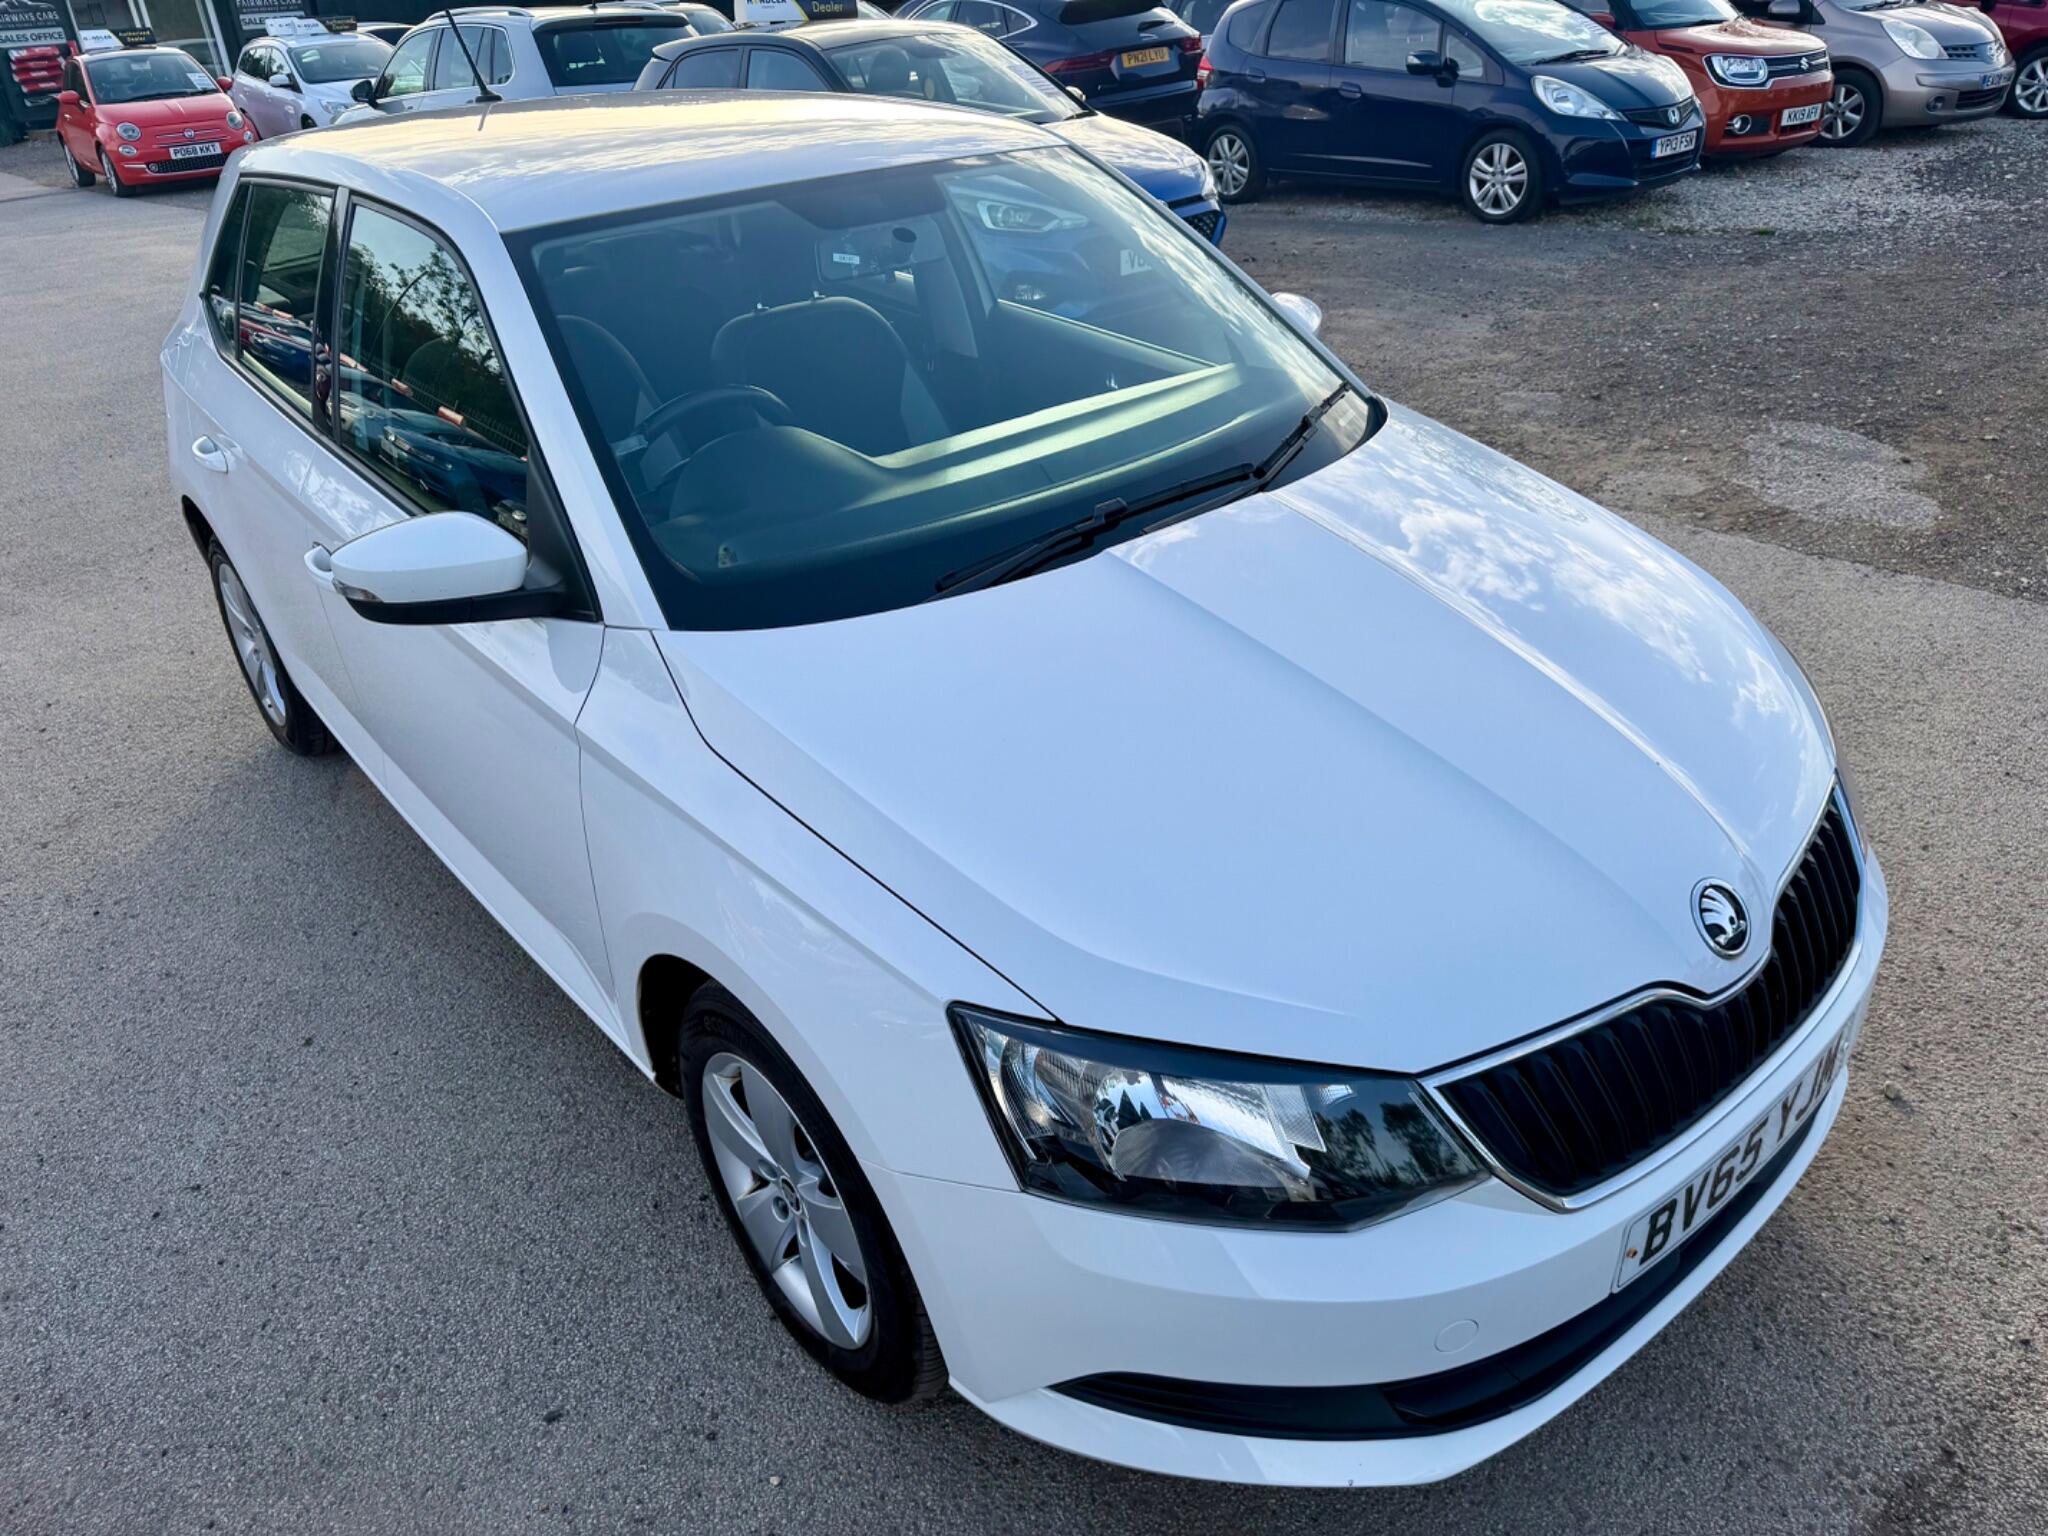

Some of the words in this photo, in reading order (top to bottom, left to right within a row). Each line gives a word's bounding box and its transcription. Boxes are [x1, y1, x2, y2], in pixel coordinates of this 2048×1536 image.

[812, 1, 843, 12] Dealer
[36, 10, 60, 20] CARS
[241, 16, 268, 26] SALE
[0, 33, 29, 43] SALES
[30, 31, 65, 41] OFFICE
[1660, 136, 1679, 154] YP13
[1639, 1116, 1770, 1266] BV65
